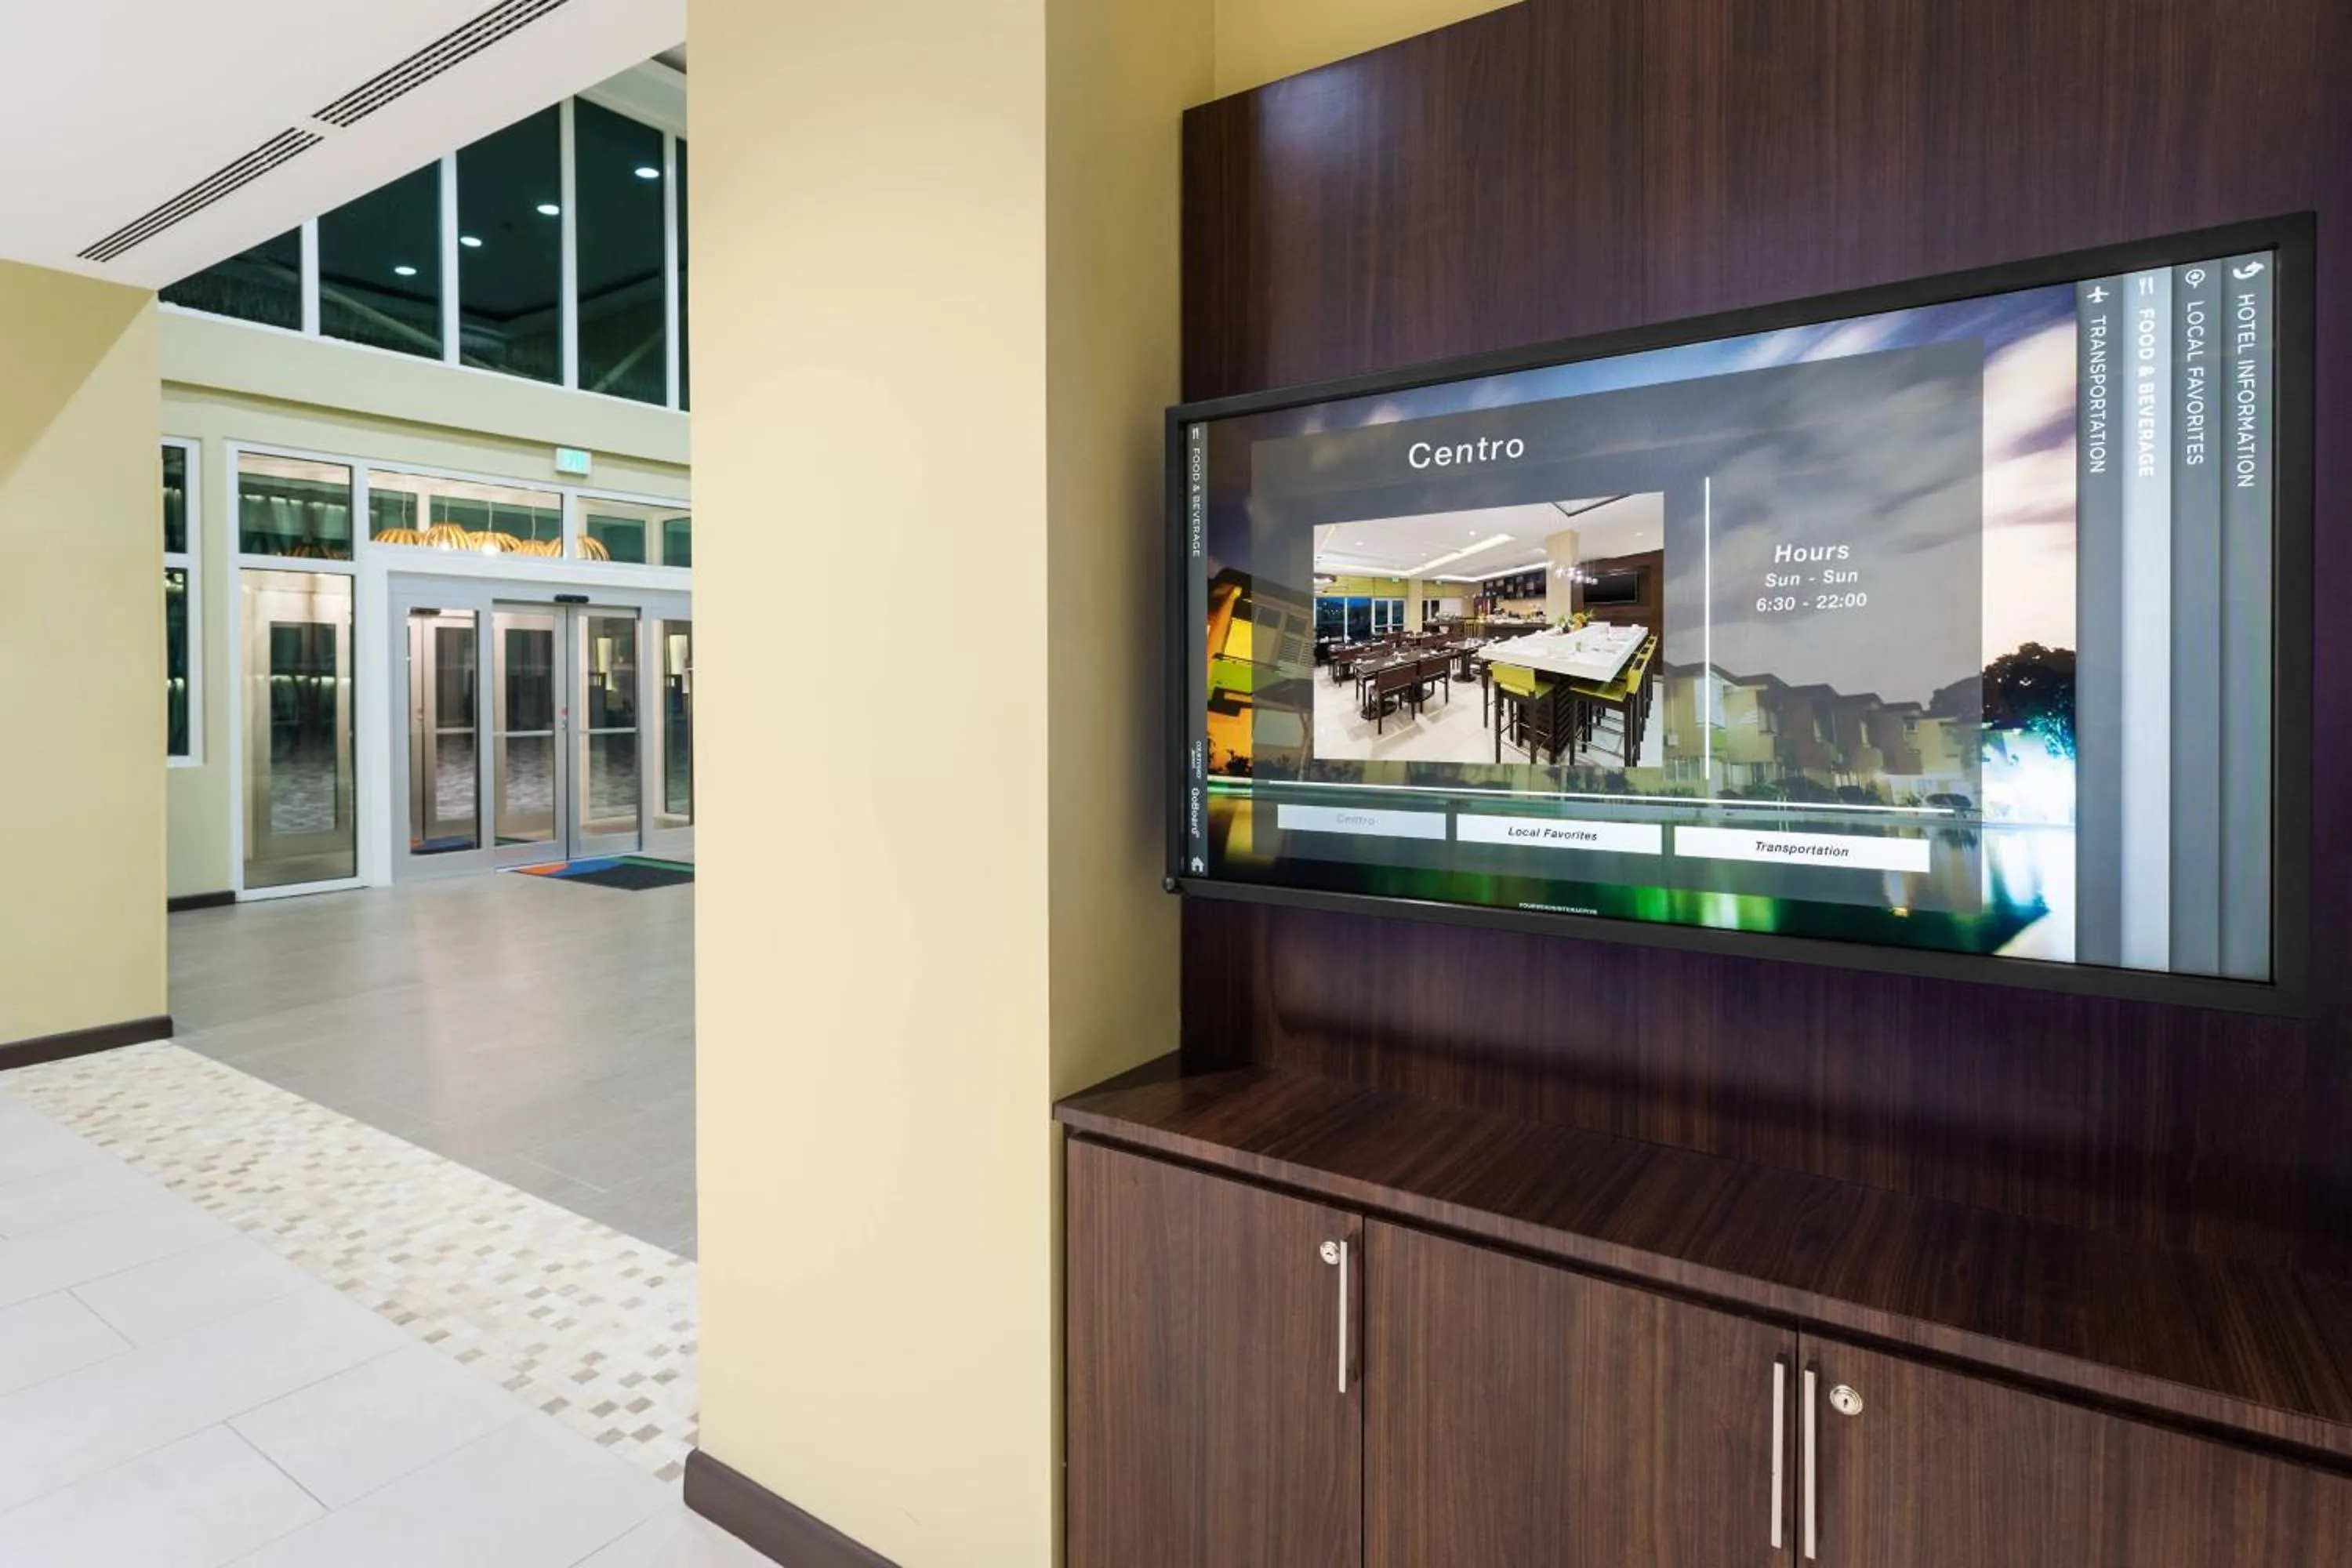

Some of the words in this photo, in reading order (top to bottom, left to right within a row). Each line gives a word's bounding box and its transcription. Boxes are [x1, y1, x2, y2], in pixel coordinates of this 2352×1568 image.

[2138, 308, 2155, 360] FOOD
[2187, 301, 2205, 361] LOCAL
[2237, 294, 2256, 354] HOTEL
[2138, 366, 2155, 376] &
[2089, 315, 2107, 473] TRANSPORTATION
[2138, 383, 2155, 477] BEVERAGE
[2187, 367, 2205, 465] FAVORITES
[2237, 360, 2256, 487] INFORMATION
[1408, 436, 1525, 470] Centro
[1773, 543, 1850, 564] Hours
[1765, 572, 1801, 588] Sun
[1822, 568, 1859, 584] Sun
[1755, 596, 1796, 612] 6:30
[1816, 592, 1867, 610] 22:00
[1335, 813, 1376, 826] Centro
[1508, 826, 1541, 838] Local
[1543, 827, 1598, 842] Favorites
[1755, 840, 1849, 857] Transportation
